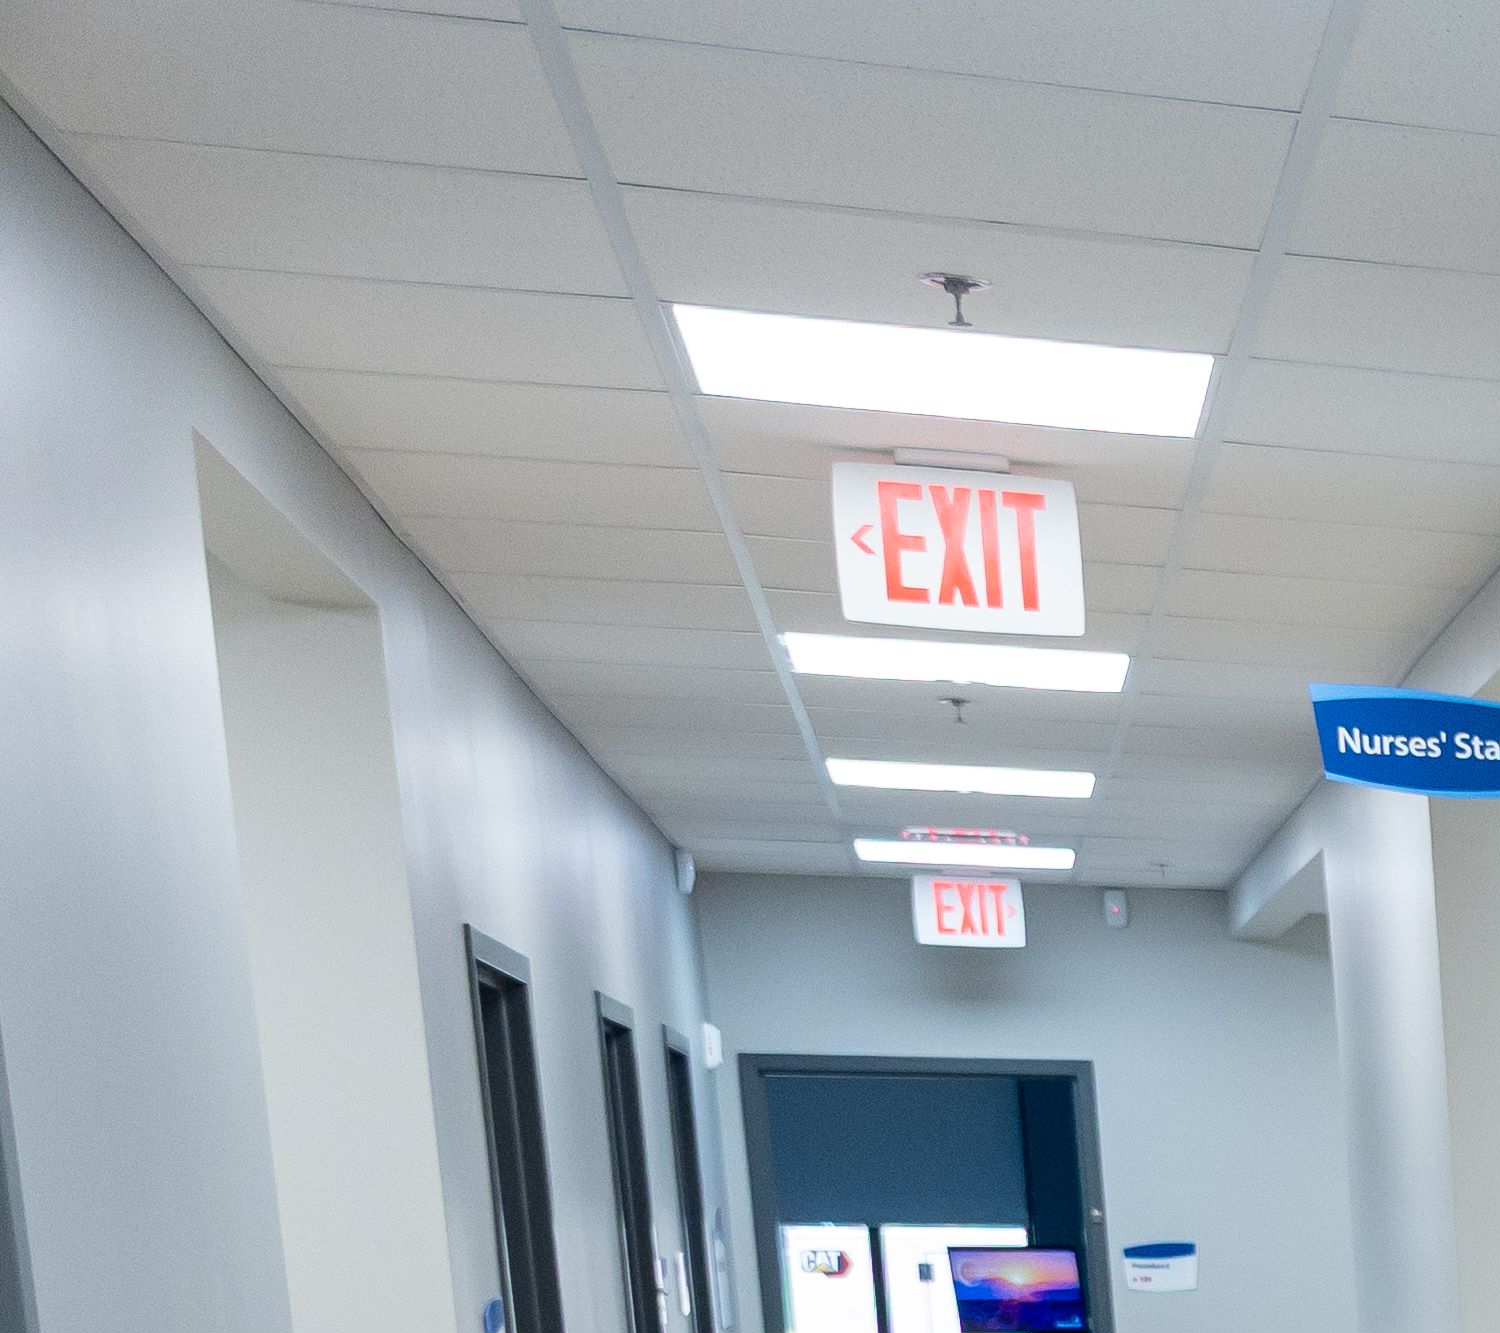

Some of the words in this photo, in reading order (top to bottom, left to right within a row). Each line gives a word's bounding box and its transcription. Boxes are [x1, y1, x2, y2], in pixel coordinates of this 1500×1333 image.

[878, 480, 1046, 612] EXIT
[1337, 725, 1447, 758] Nurses'
[931, 879, 1009, 937] EXIT
[800, 1250, 842, 1273] CAT
